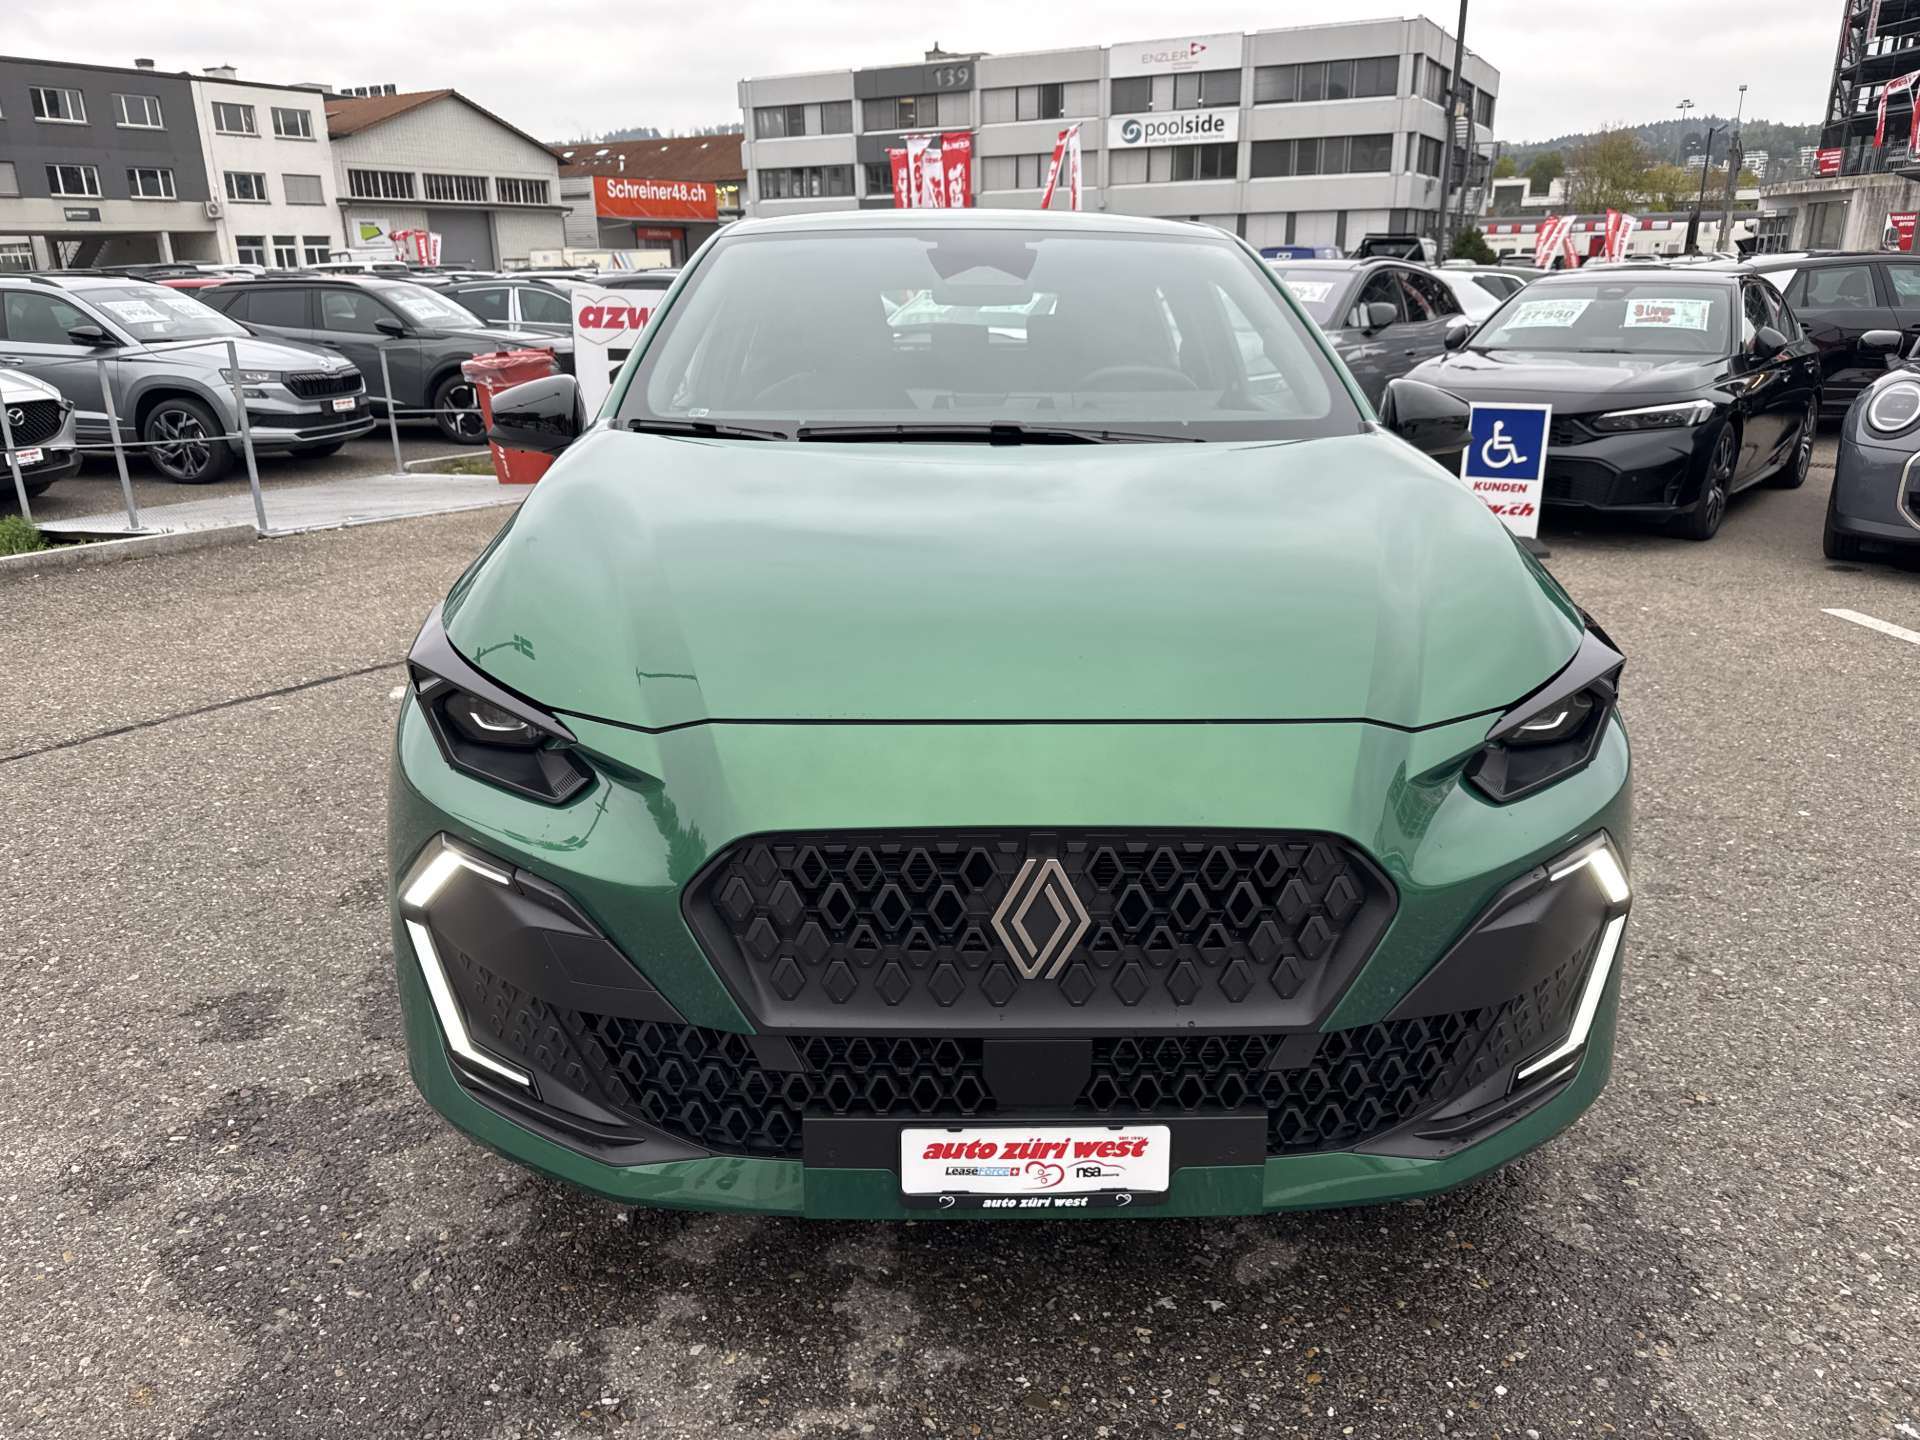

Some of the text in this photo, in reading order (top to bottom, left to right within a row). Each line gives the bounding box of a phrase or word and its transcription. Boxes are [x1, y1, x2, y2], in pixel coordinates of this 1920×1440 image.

[1141, 51, 1189, 64] ENZLER
[933, 67, 969, 86] 139
[1145, 114, 1225, 143] poolside
[607, 179, 706, 202] Schreiner48.ch
[1473, 481, 1528, 493] KUNDEN
[1487, 503, 1535, 517] w.ch
[922, 1137, 1149, 1159] auto züri west
[1076, 1166, 1101, 1178] nsa
[982, 1196, 1088, 1207] auto züri west
